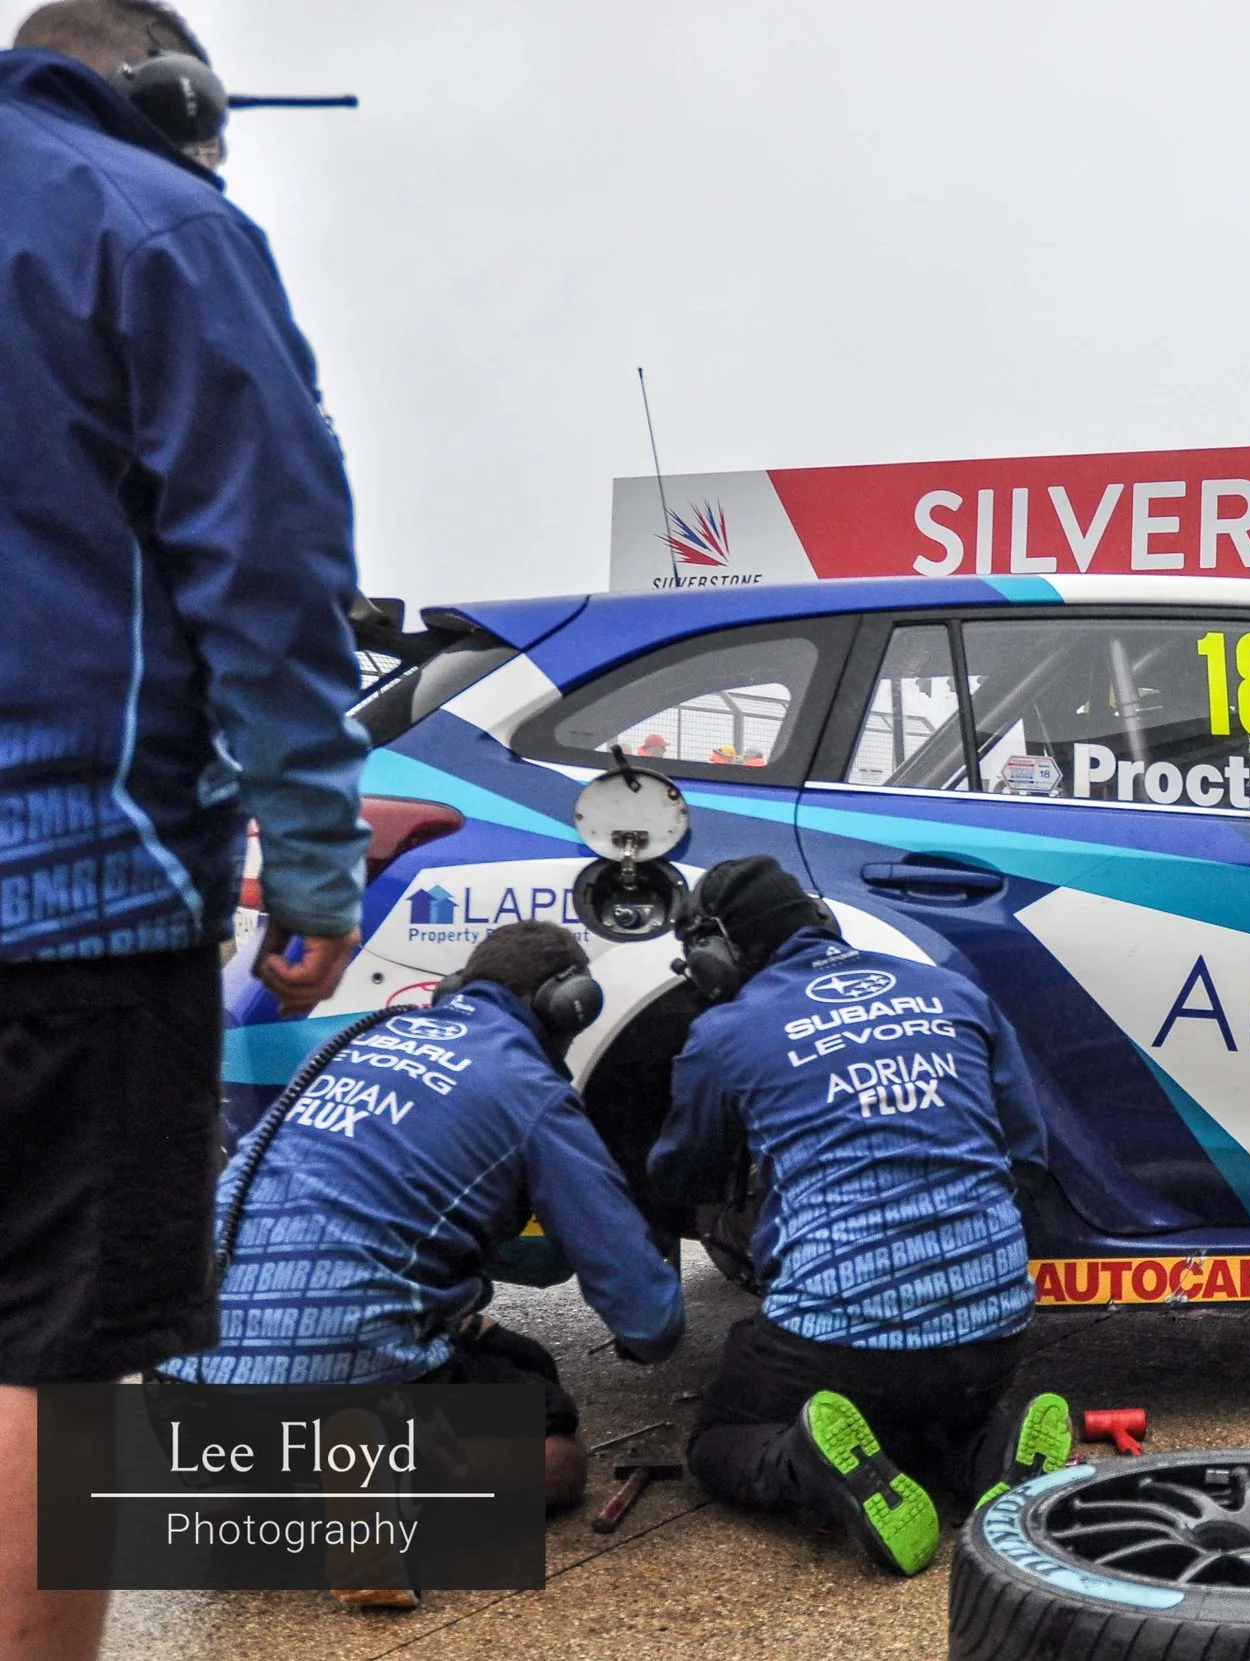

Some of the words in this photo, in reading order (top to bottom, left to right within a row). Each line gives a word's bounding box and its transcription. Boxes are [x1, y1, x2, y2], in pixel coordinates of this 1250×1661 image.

[409, 928, 479, 944] Property
[784, 996, 943, 1040] SUBARU
[350, 1033, 472, 1072] UBARU
[788, 1019, 956, 1067] LEVORG
[826, 1053, 957, 1103] ADRIAN
[858, 1079, 945, 1118] FLUX
[284, 1097, 370, 1138] FLUX
[303, 1074, 415, 1125] DRIAN
